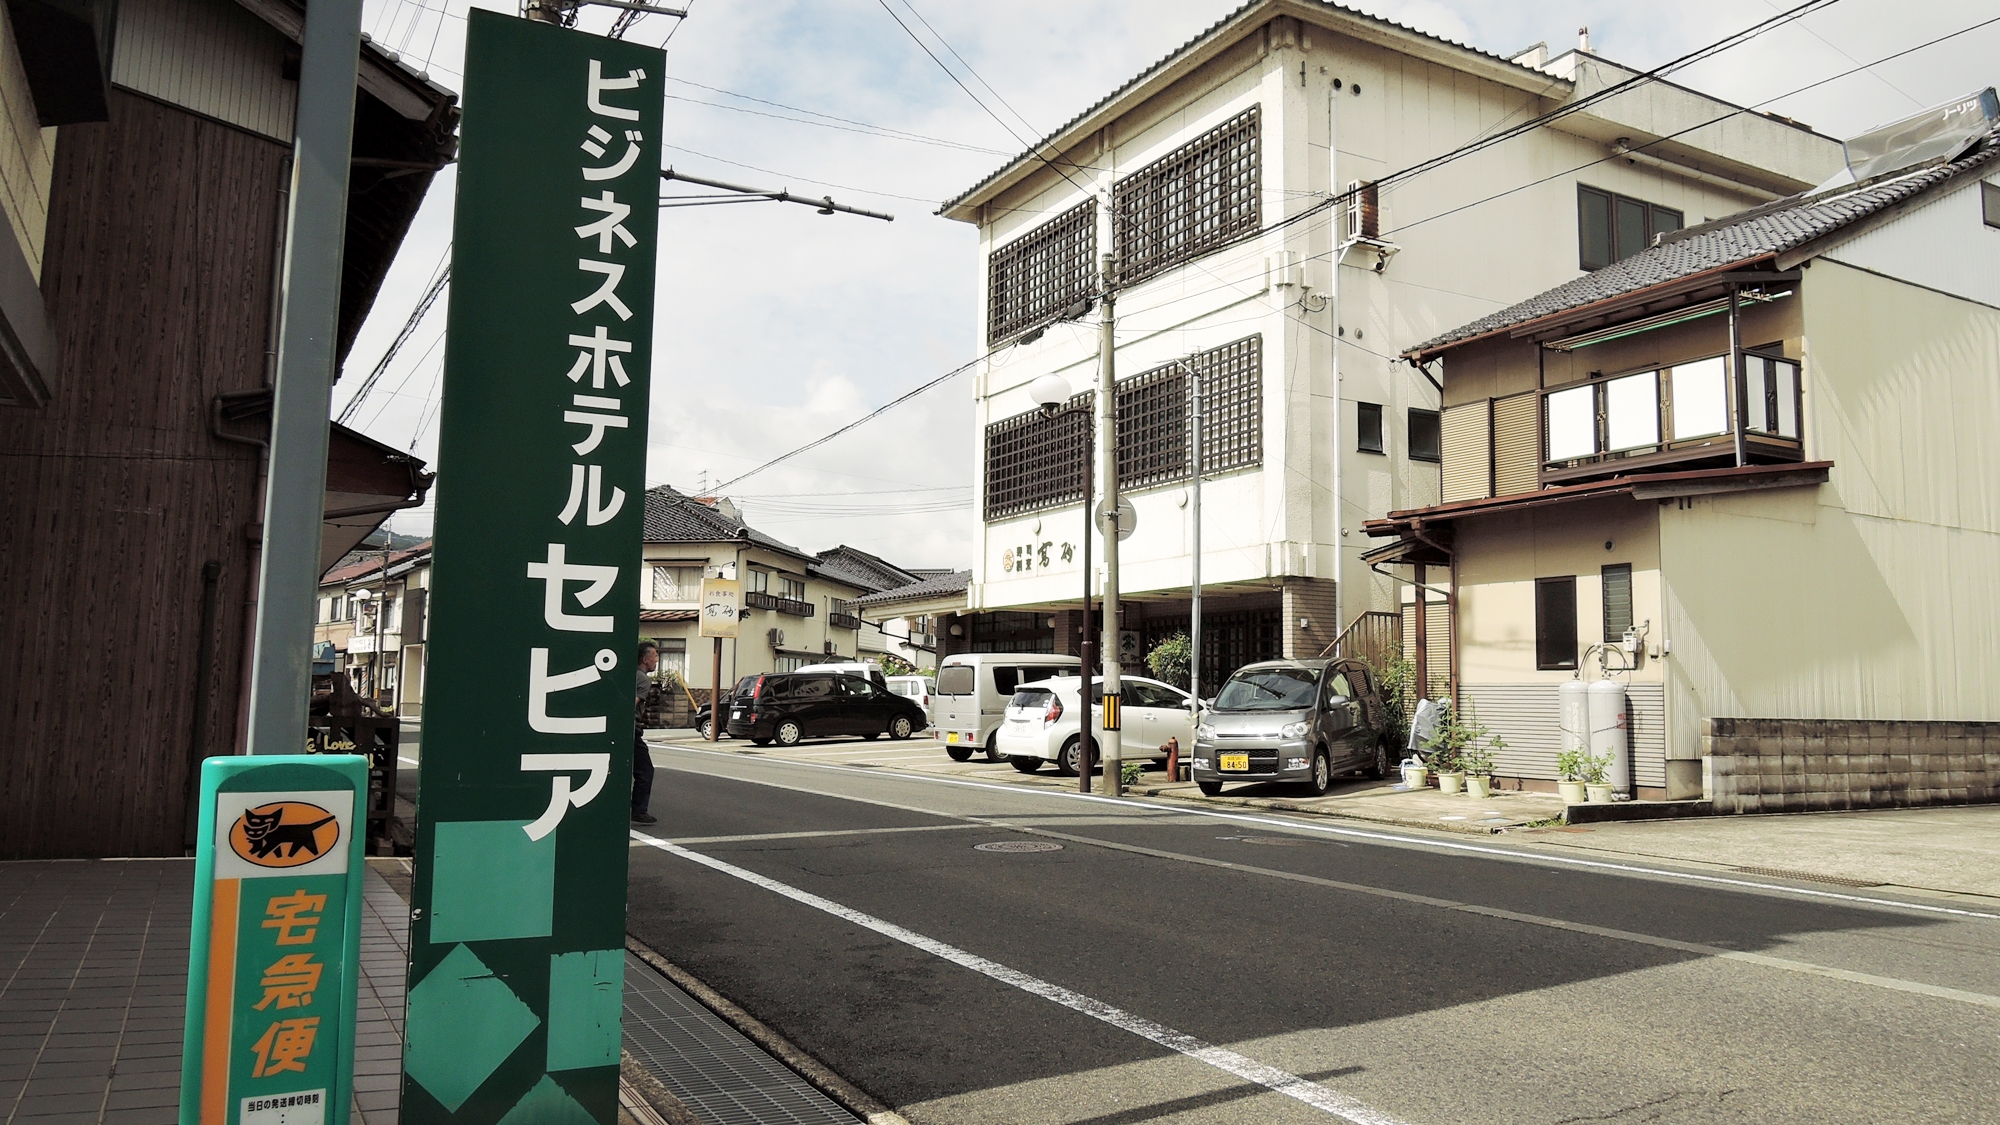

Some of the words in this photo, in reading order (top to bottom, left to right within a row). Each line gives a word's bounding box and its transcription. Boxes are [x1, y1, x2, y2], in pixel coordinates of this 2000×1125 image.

[1942, 99, 1977, 120] ノーリツ
[251, 889, 327, 1078] 宅急便
[248, 1093, 320, 1112] 当日の発送締切時刻
